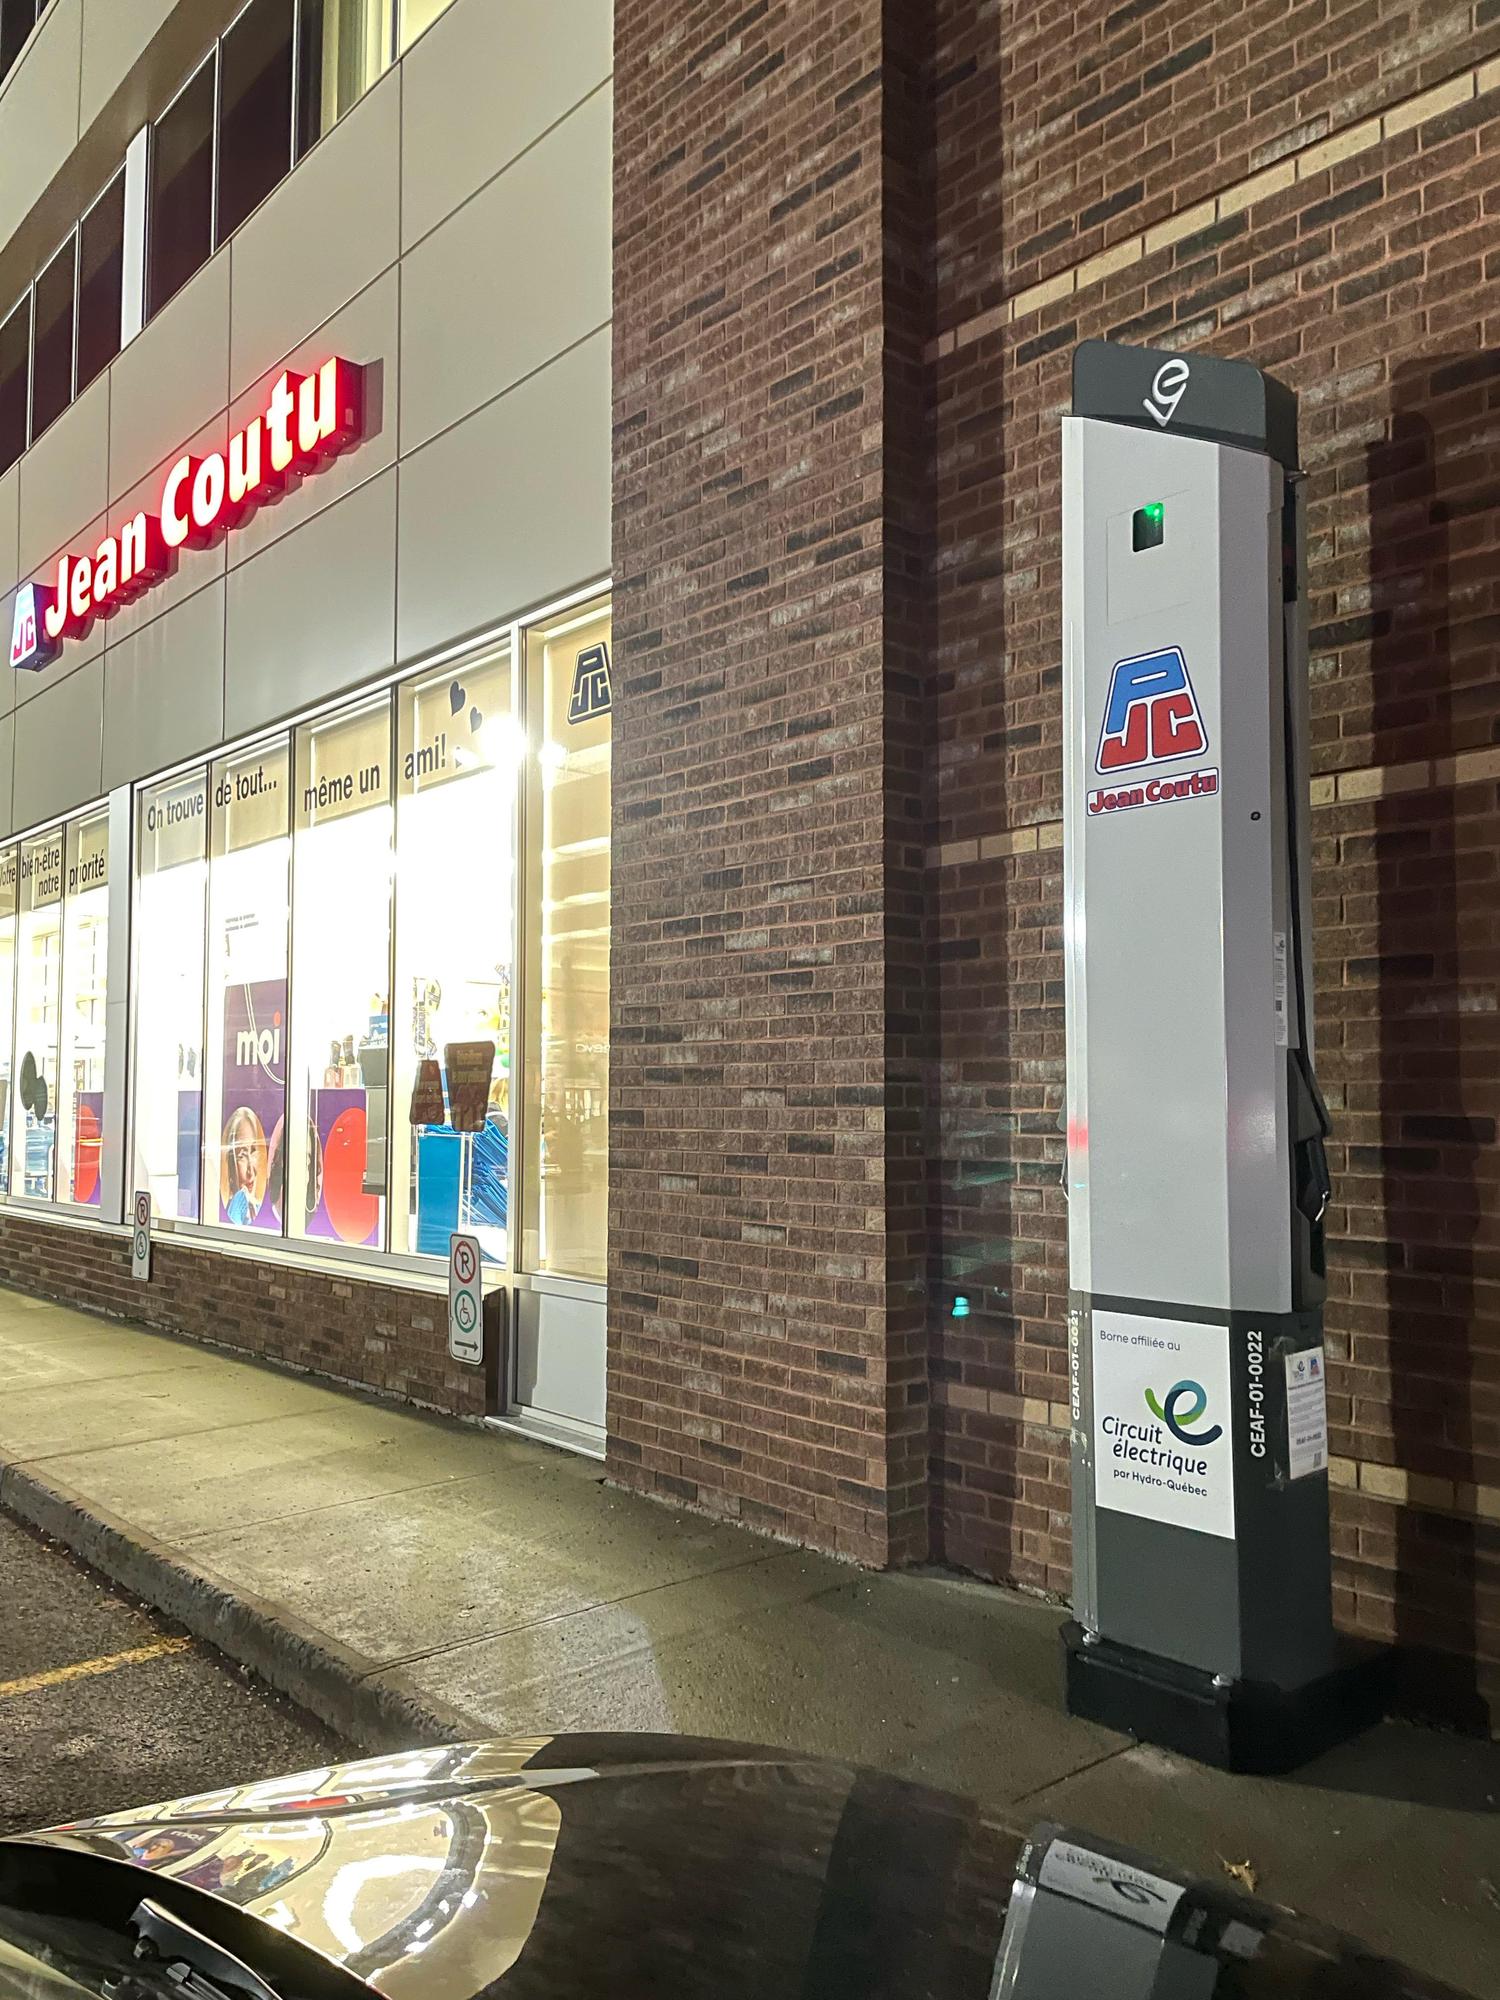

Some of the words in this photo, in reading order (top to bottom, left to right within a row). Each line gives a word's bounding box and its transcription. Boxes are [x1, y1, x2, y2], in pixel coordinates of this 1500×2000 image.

[45, 511, 147, 639] Jean
[160, 356, 337, 547] Coutu
[1098, 649, 1205, 771] PJC
[148, 805, 163, 831] On
[167, 793, 204, 825] trouve
[216, 779, 231, 807] de
[236, 766, 277, 800] tout...
[304, 776, 353, 812] même
[359, 765, 380, 794] un
[404, 733, 446, 780] ami!
[1089, 788, 1144, 813] Jean
[1146, 772, 1216, 802] Coutu
[22, 847, 60, 879] bien-être
[39, 874, 59, 897] notre
[69, 849, 105, 893] priorité
[236, 1010, 281, 1066] moi
[1100, 1330, 1129, 1343] Borne
[1131, 1335, 1165, 1349] affiliée
[1167, 1342, 1181, 1351] au
[1071, 1309, 1081, 1421] CEAF-01-0021
[1247, 1331, 1266, 1458] CEAF-01-0022
[1102, 1416, 1163, 1444] Circuit
[1112, 1438, 1207, 1475] électrique
[1113, 1469, 1130, 1478] par
[1132, 1471, 1207, 1496] Hydro-Québec
